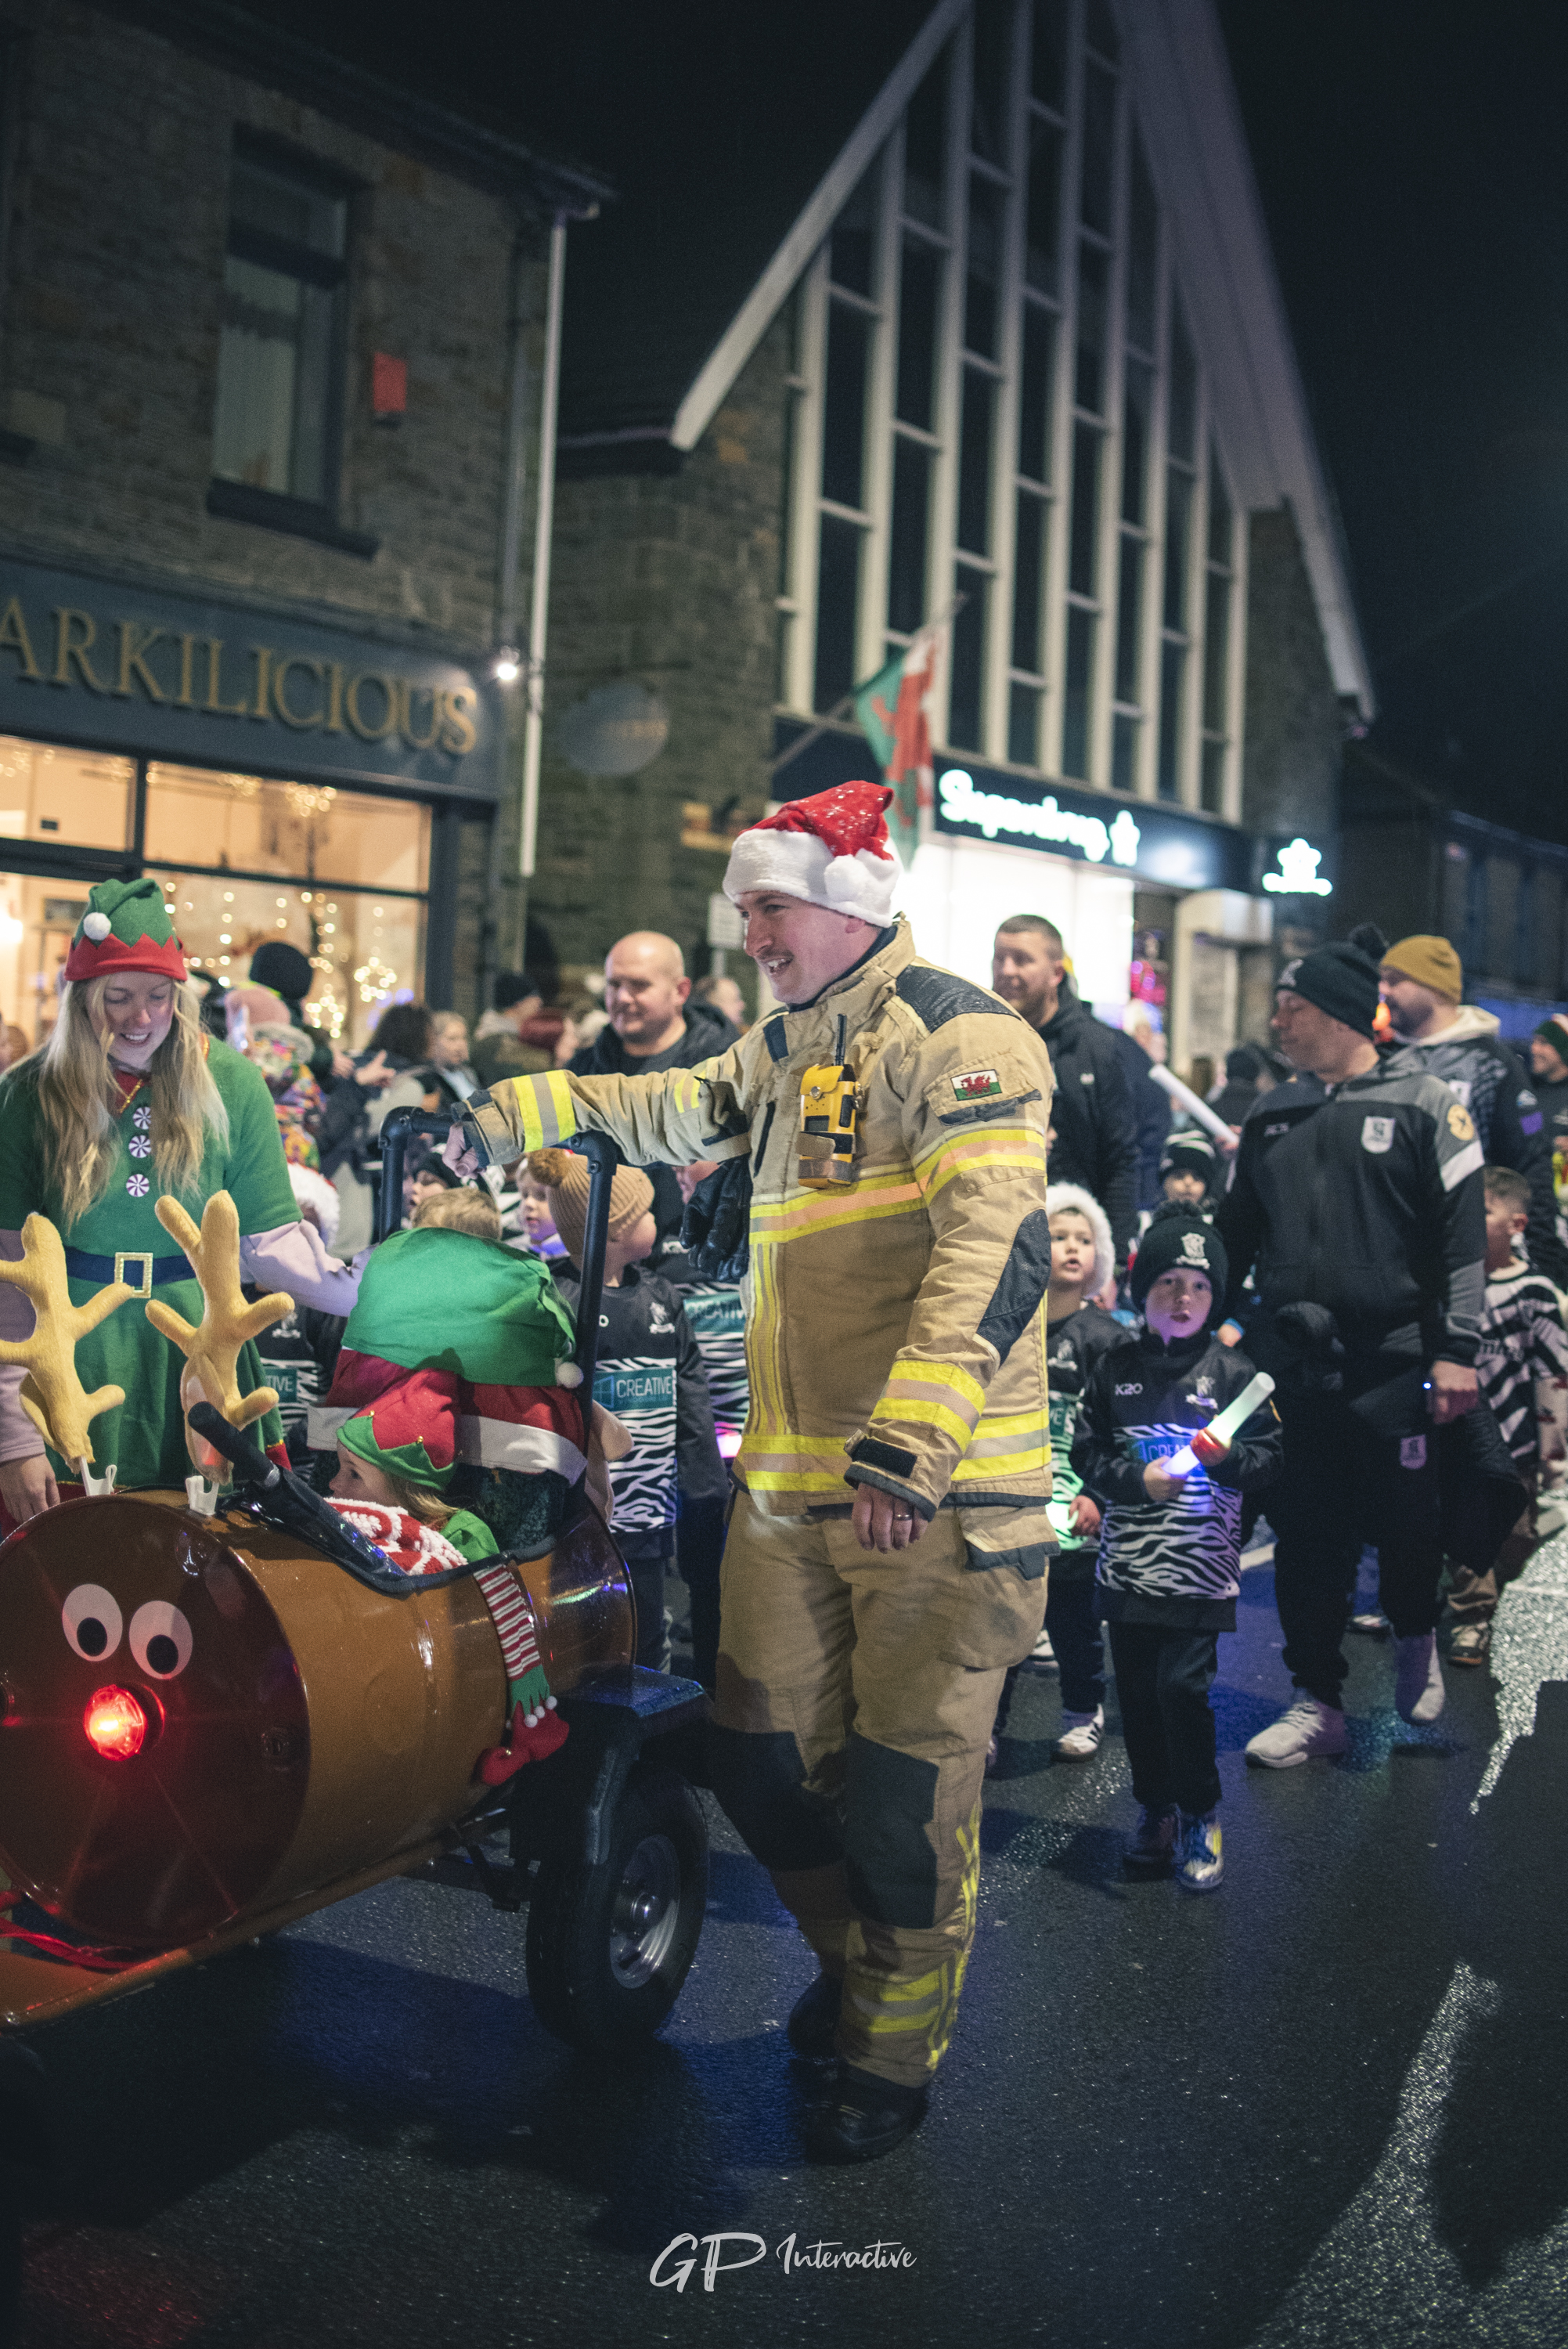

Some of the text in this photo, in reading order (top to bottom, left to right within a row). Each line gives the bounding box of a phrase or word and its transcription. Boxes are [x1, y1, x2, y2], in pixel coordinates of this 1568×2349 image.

[0, 597, 478, 755] ARKILICIOUS
[266, 1374, 294, 1393] TIVE
[615, 1376, 672, 1398] CREATIVE
